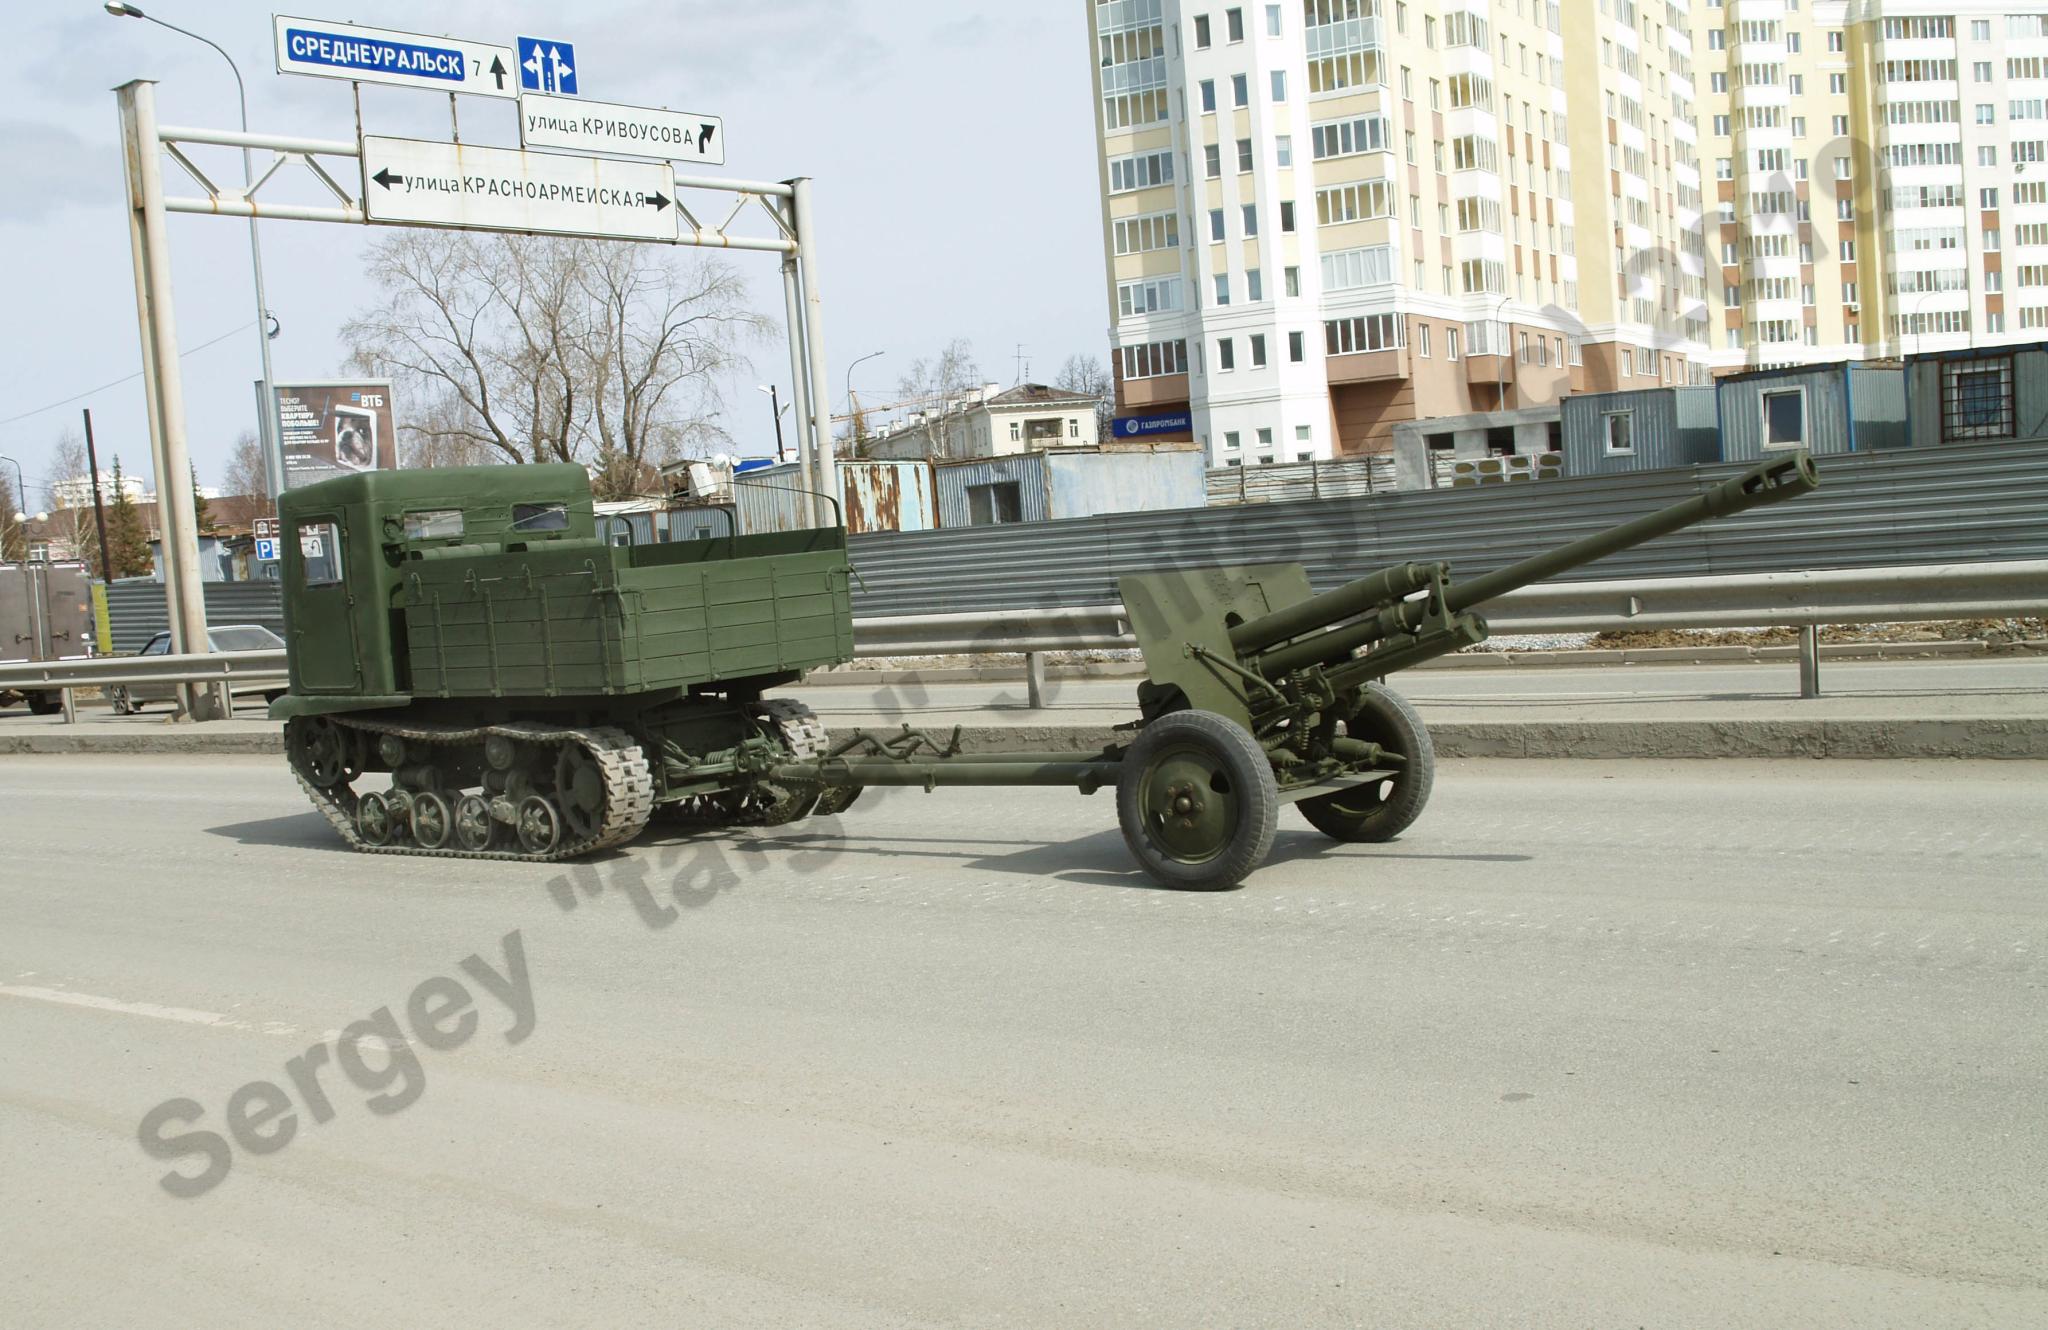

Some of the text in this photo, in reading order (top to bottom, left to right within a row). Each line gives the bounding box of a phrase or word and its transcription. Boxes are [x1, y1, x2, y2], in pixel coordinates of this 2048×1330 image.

[291, 35, 481, 77] СРЕДНЕУРАЛЬСК 7
[528, 115, 694, 145] улица КРИВОУСОВА
[405, 176, 460, 194] улица
[361, 394, 384, 407] ВТБ
[1141, 418, 1186, 429] ГАЗПРОМБАНК
